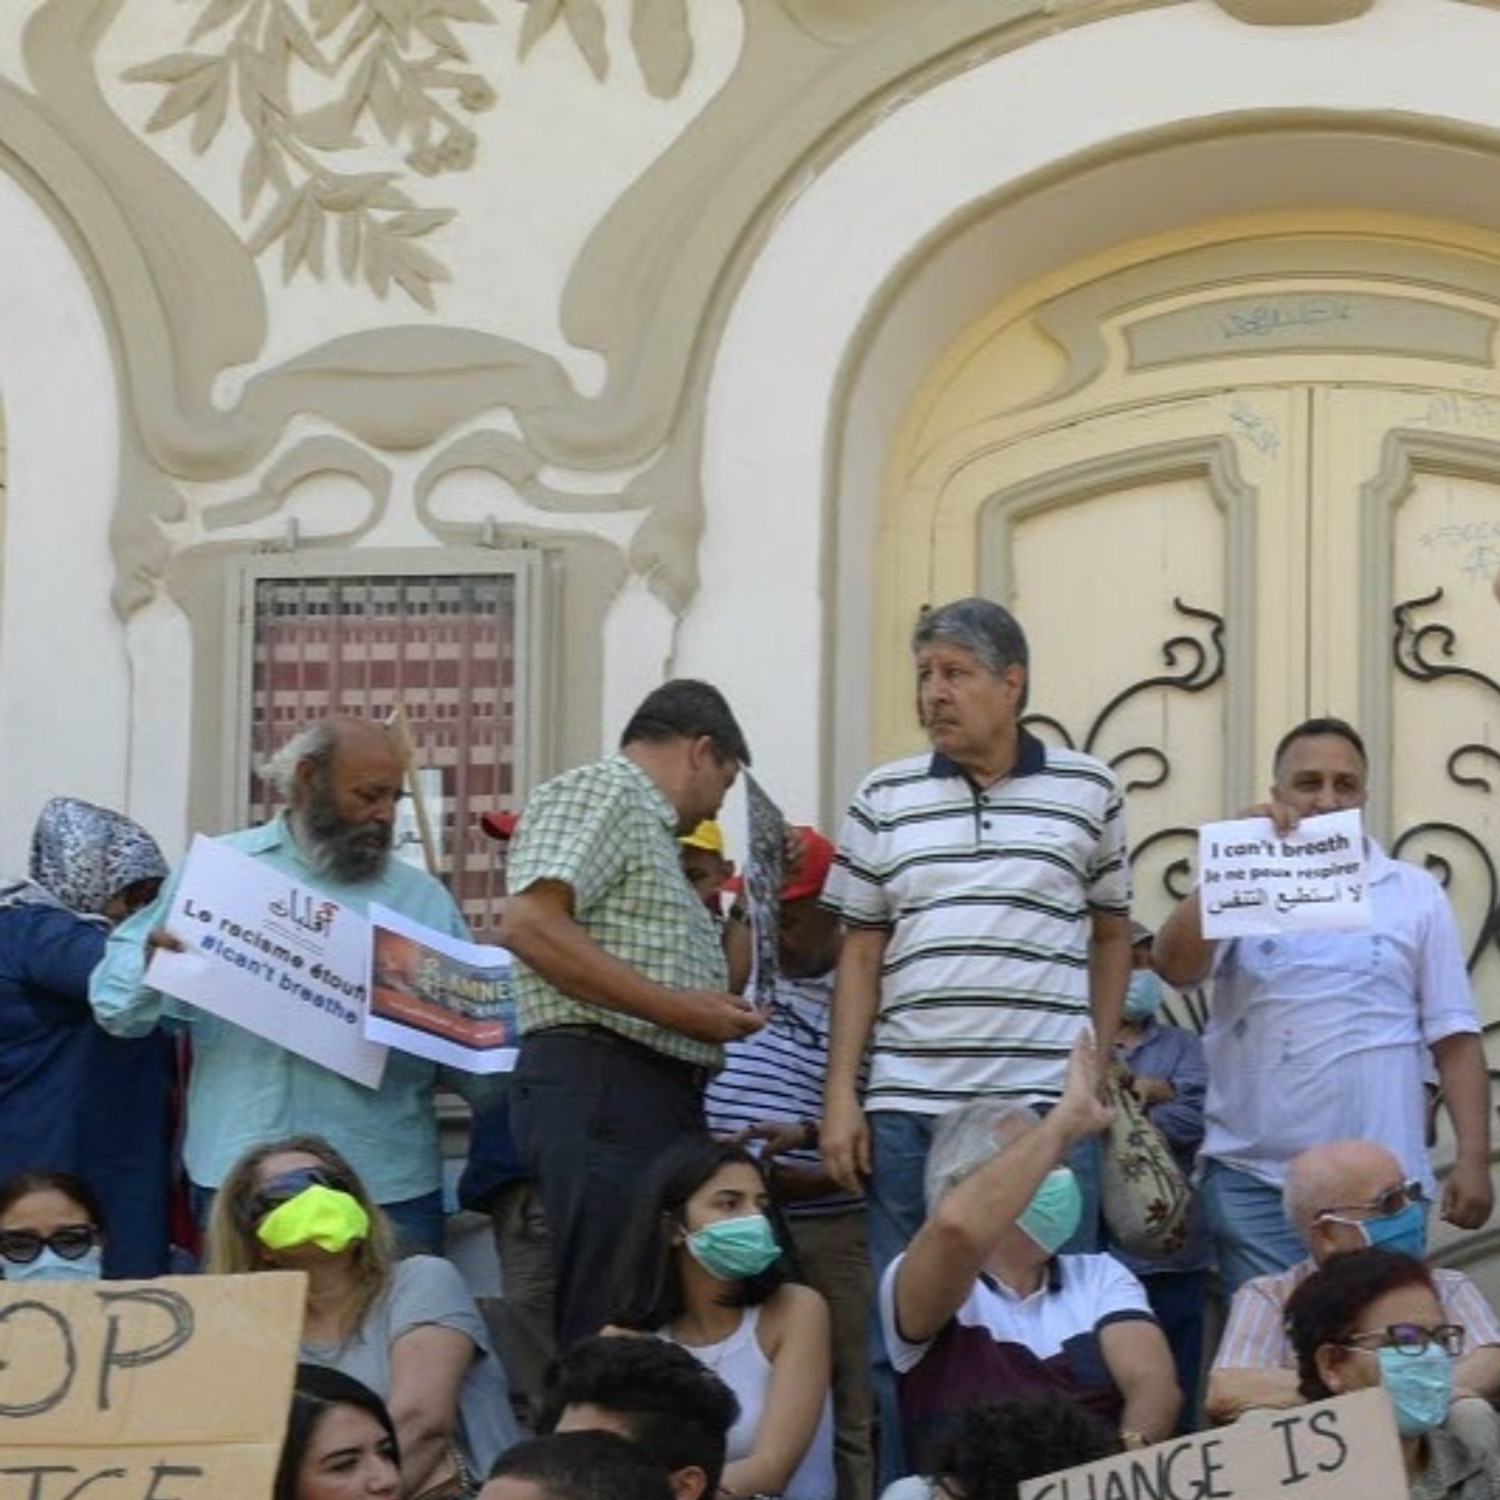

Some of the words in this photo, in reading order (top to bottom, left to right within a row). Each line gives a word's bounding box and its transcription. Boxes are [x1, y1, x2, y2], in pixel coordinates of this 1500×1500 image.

[1211, 842, 1219, 858] I
[1223, 840, 1276, 858] can't
[1280, 834, 1350, 858] breath
[219, 914, 305, 970] racisme
[1271, 1408, 1349, 1486] IS
